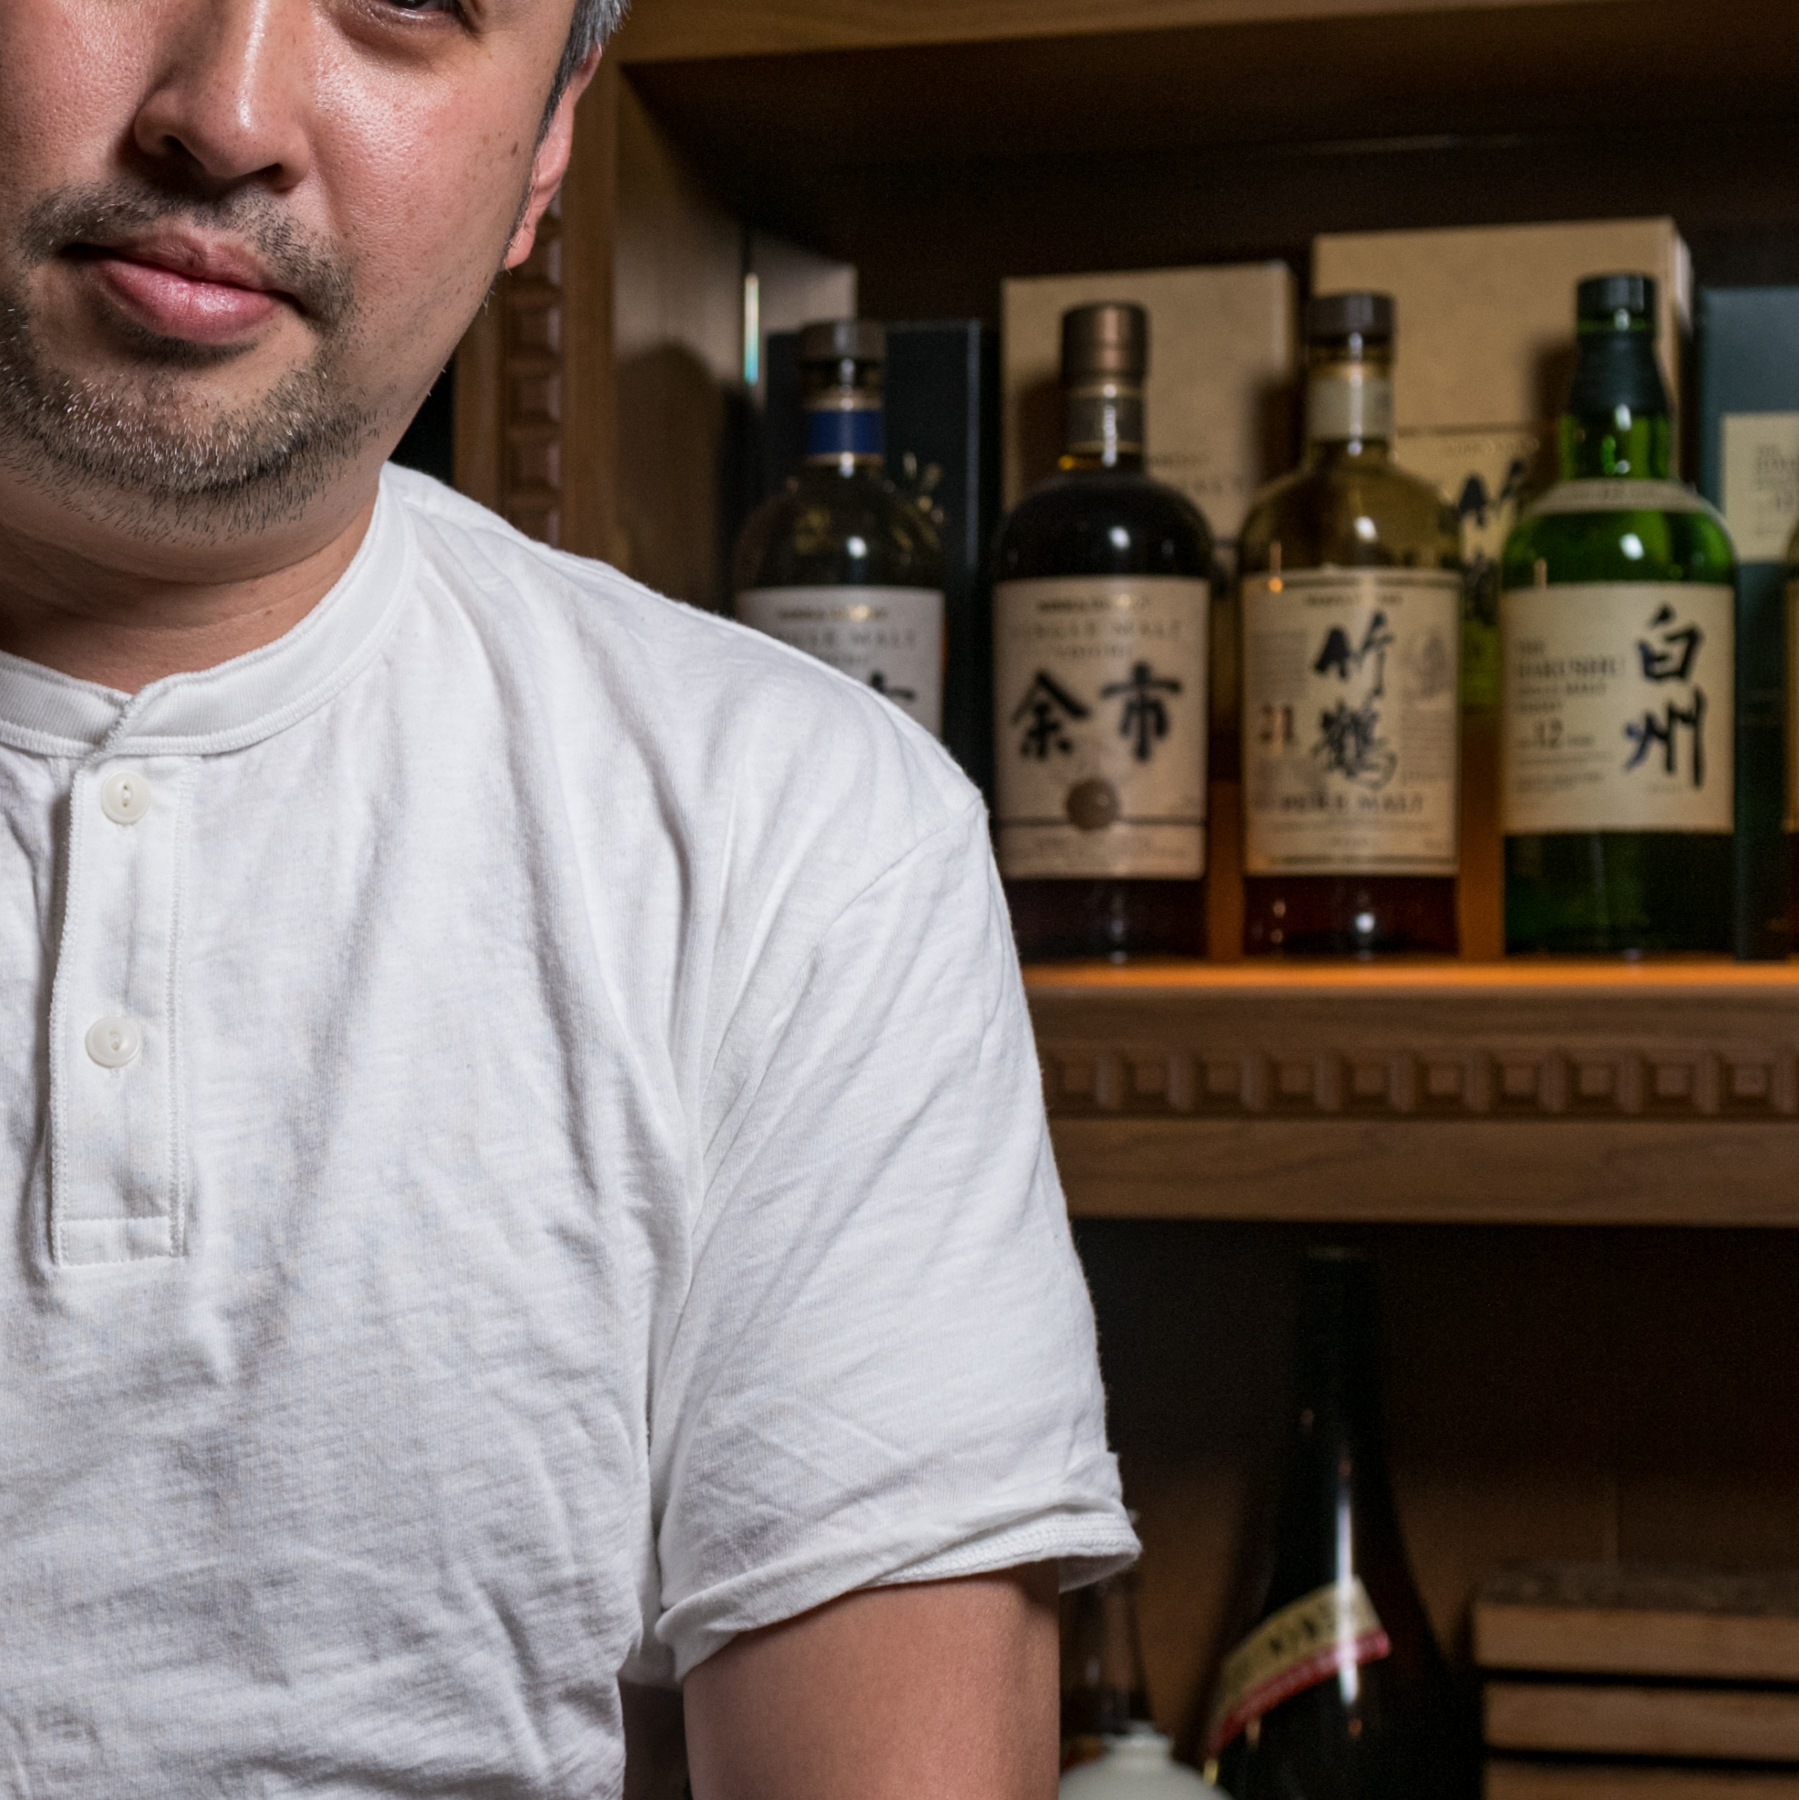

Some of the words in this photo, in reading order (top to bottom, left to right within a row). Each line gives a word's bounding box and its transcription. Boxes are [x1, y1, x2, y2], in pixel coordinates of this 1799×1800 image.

[1010, 660, 1185, 765] 余市
[1313, 609, 1398, 791] 竹鶴
[1623, 603, 1708, 790] 白州
